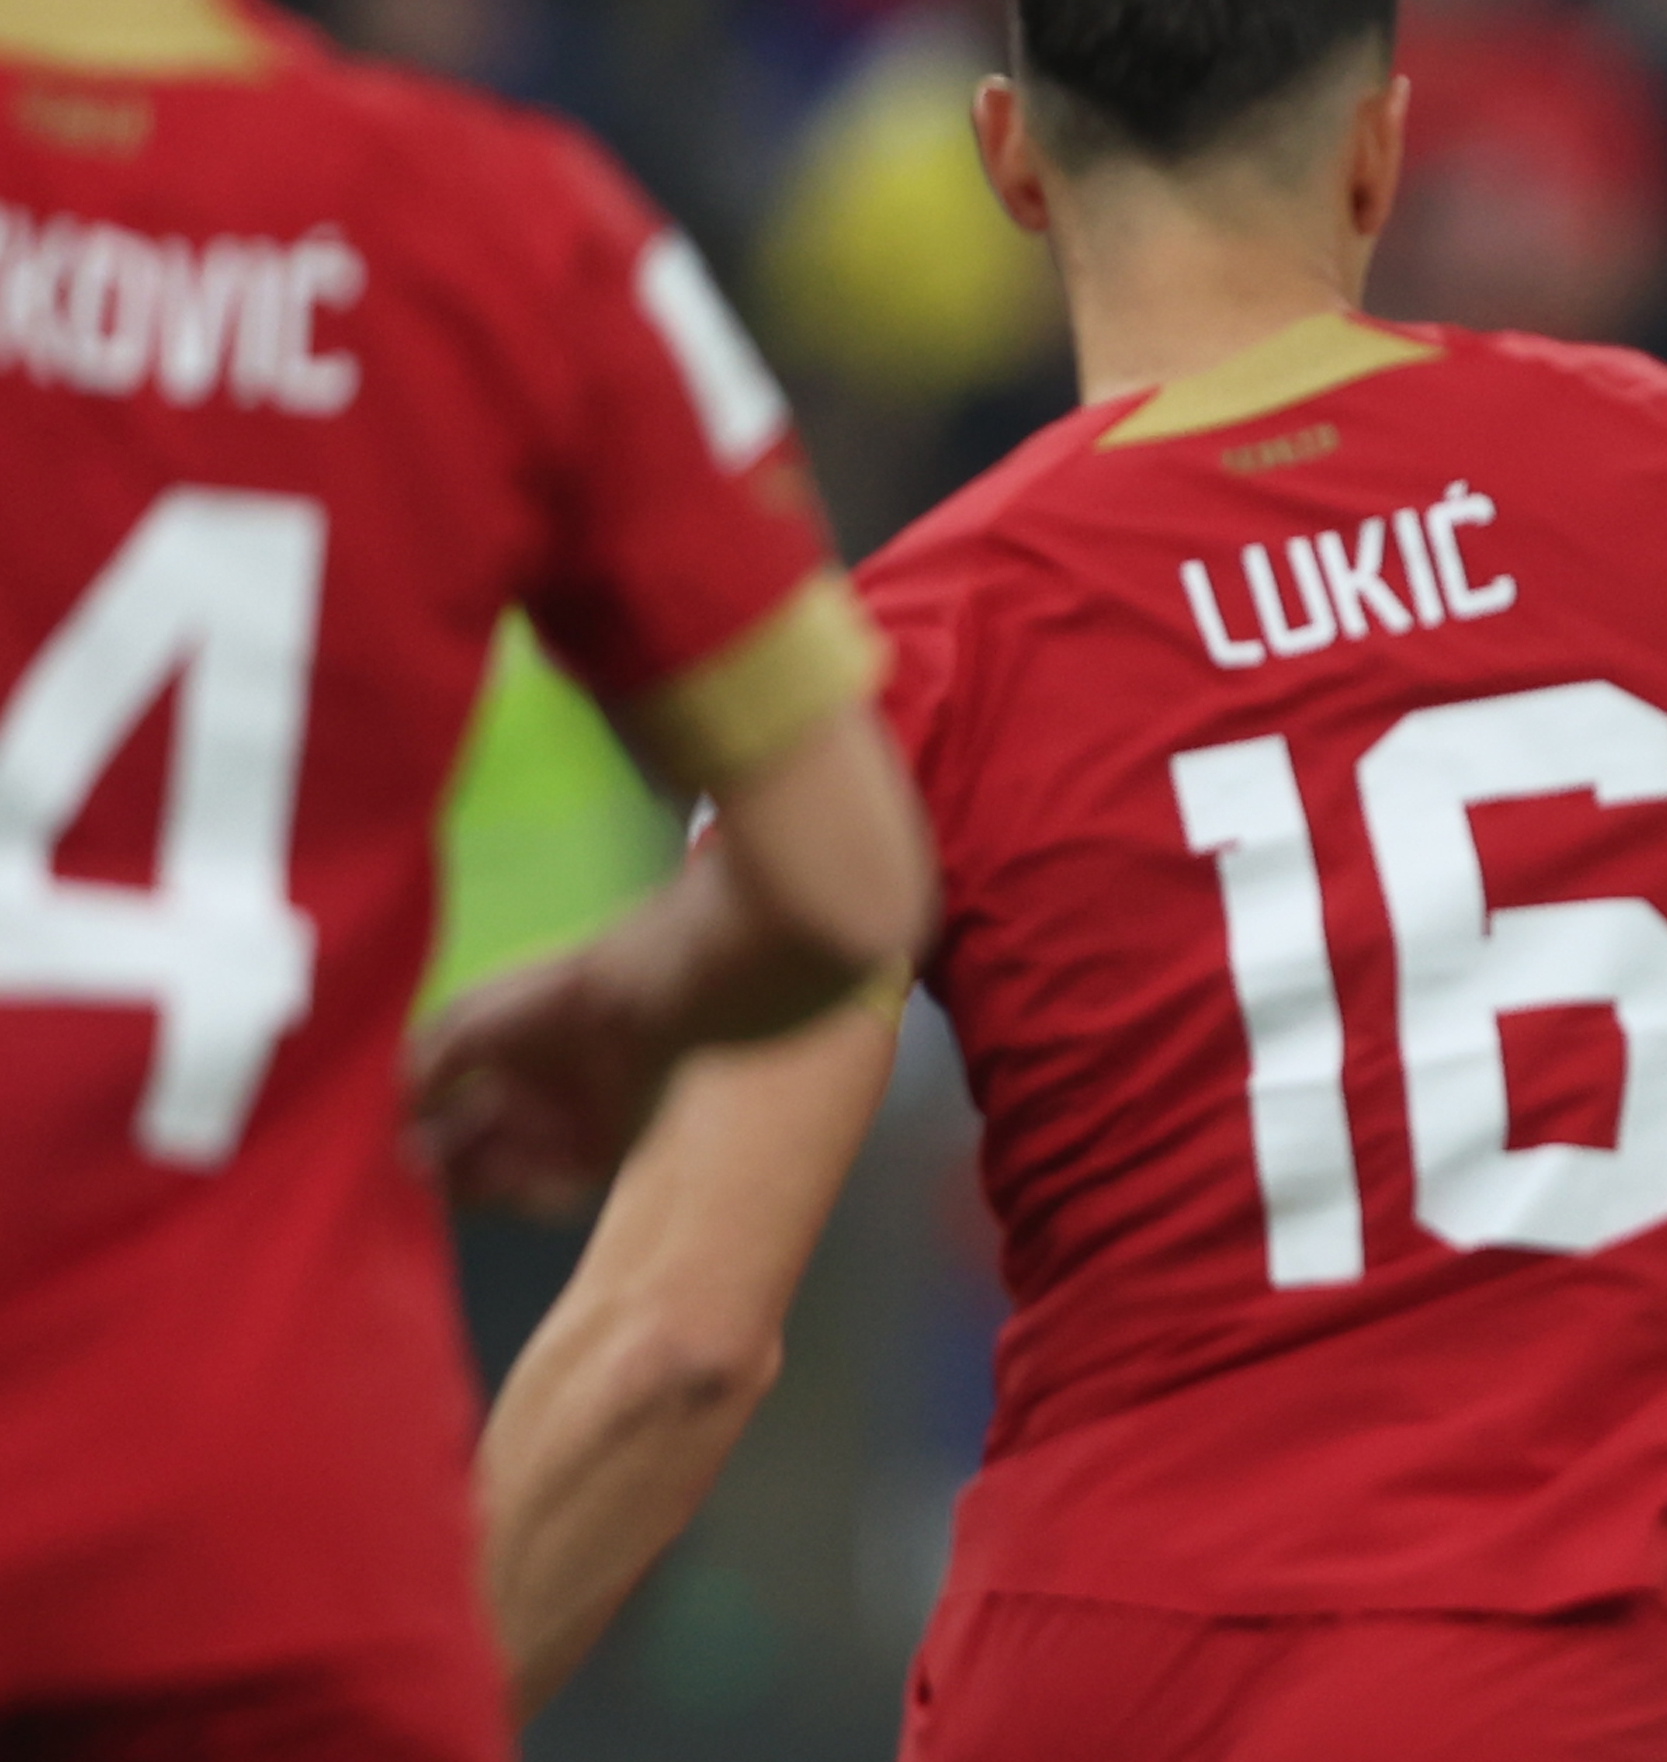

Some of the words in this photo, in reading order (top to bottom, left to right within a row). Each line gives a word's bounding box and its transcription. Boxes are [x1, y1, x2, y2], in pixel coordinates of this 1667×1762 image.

[0, 196, 366, 416] KOVIĆ
[1180, 480, 1517, 668] LUKIĆ
[0, 481, 328, 1173] 4
